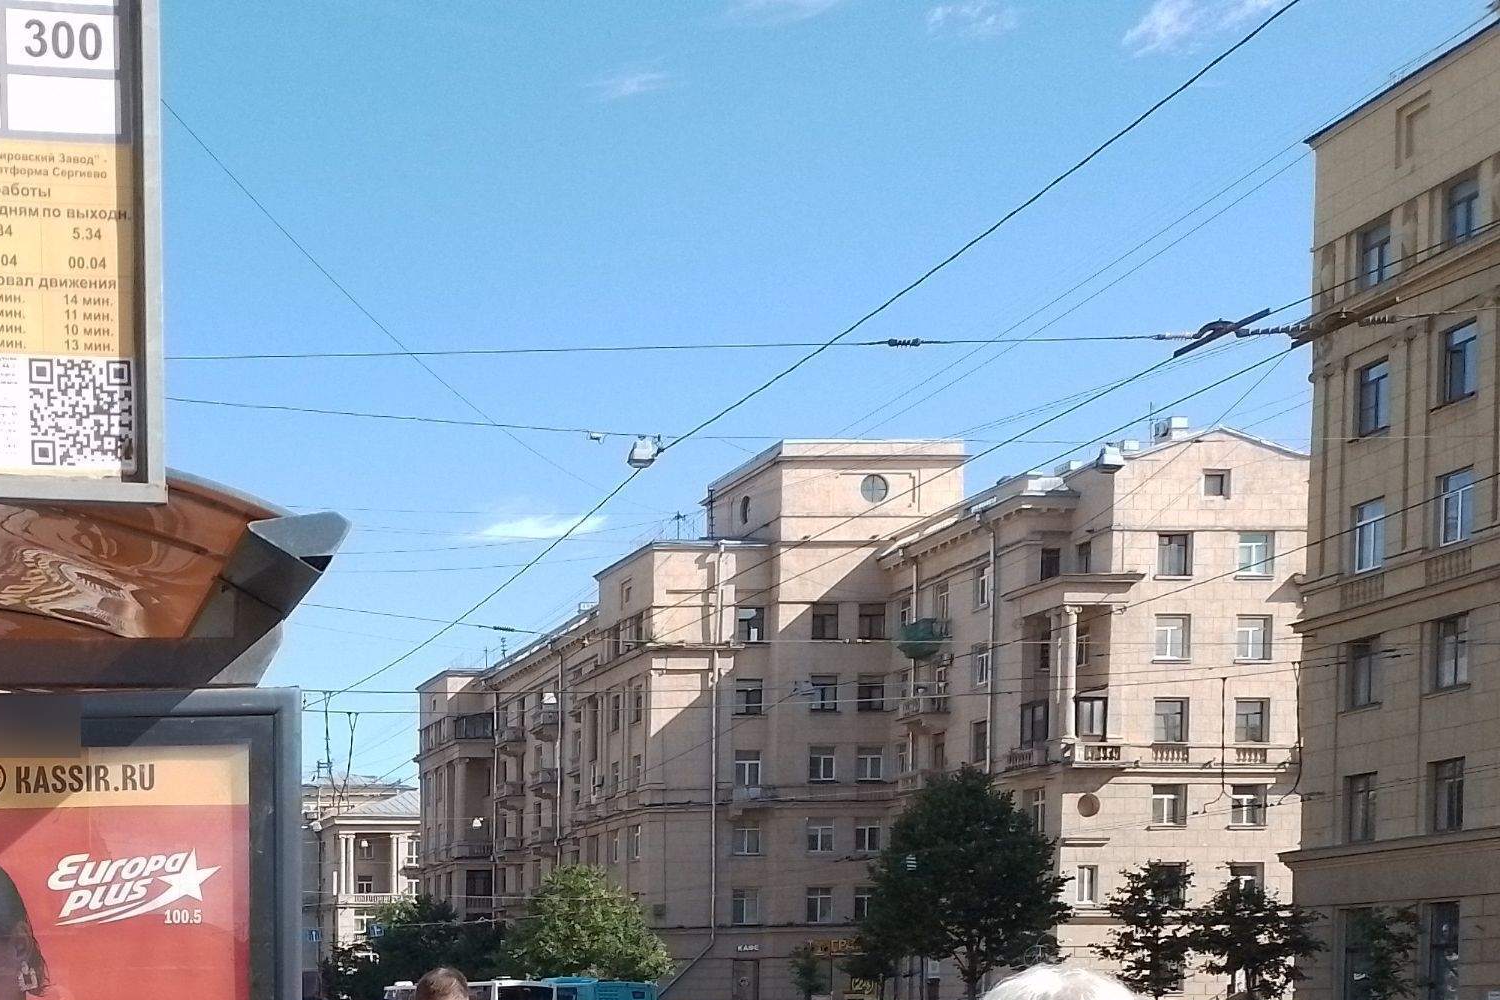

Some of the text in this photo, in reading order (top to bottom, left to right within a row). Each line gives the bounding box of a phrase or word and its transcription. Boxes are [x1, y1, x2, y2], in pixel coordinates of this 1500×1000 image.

[24, 19, 103, 60] 300
[59, 153, 100, 166] Завод"
[52, 167, 107, 180] Сергиево
[42, 207, 61, 218] по
[66, 205, 133, 224] выходн.
[72, 227, 102, 241] 5.34
[68, 256, 107, 270] 00.04
[38, 276, 117, 291] движения
[64, 309, 77, 321] 11
[83, 311, 114, 322] мин.
[64, 324, 78, 336] 10
[83, 326, 114, 337] мин.
[15, 761, 155, 797] KASSIR.RU
[47, 851, 191, 894] Europa
[164, 908, 202, 925] 100.5
[737, 944, 759, 952] КАФЕ
